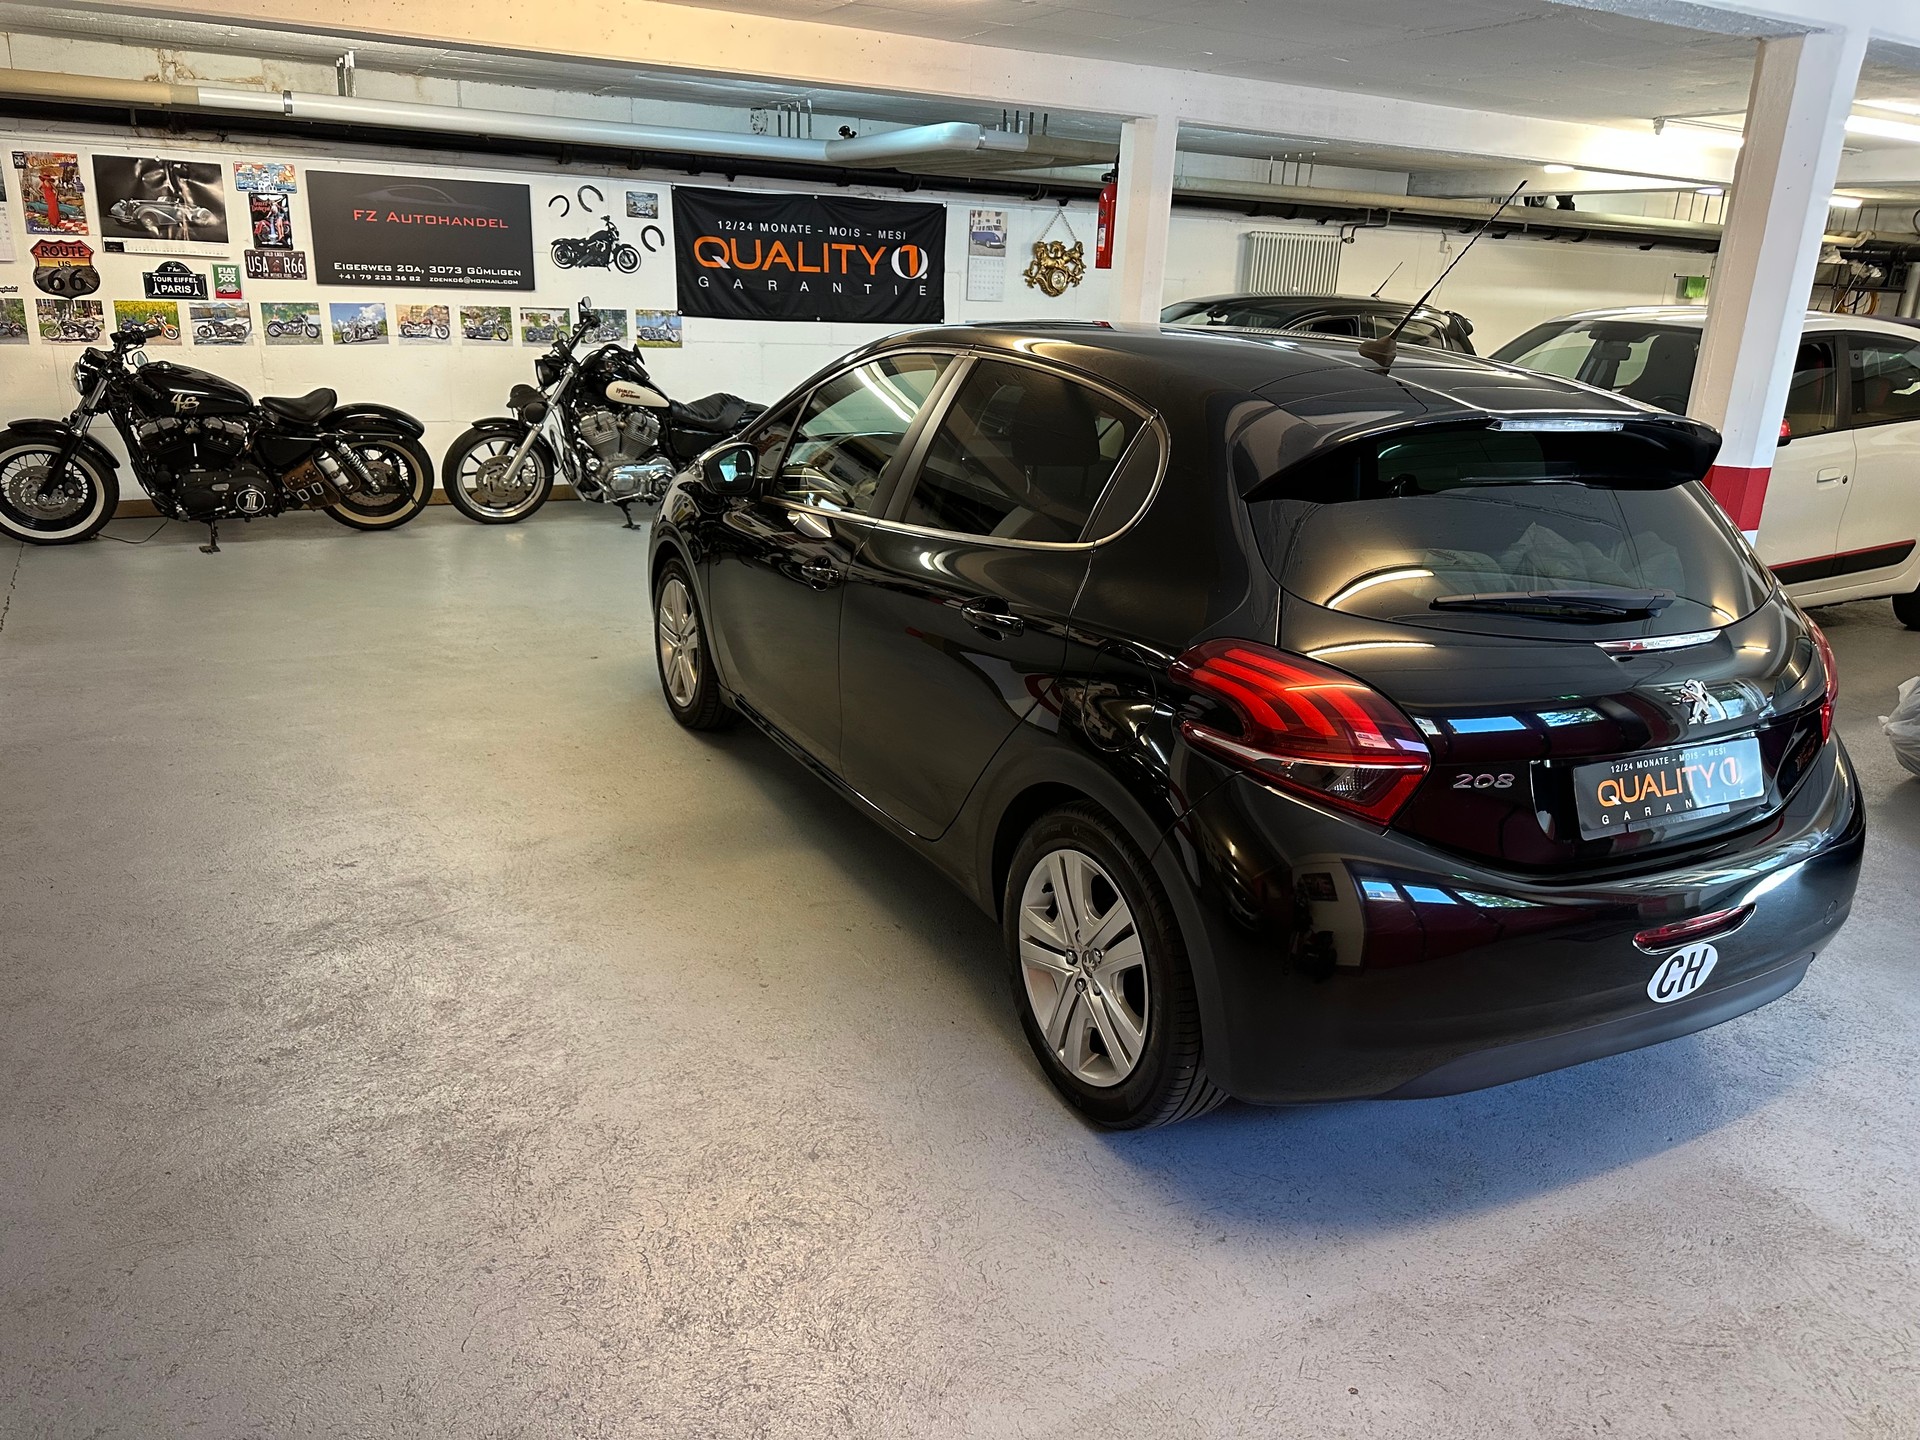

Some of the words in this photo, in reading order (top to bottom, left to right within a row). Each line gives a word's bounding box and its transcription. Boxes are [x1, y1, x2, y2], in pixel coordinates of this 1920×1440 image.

[353, 209, 378, 222] FZ
[717, 220, 753, 231] 12/24
[760, 223, 811, 234] MONATE
[829, 227, 860, 238] MOIS
[878, 230, 906, 240] MESI
[41, 245, 86, 257] ROUTE
[694, 235, 887, 276] QUALITY
[247, 256, 270, 273] USA
[283, 257, 305, 274] R66
[428, 265, 463, 275] 3073
[47, 268, 87, 291] 66
[161, 284, 192, 294] PARIS
[219, 275, 237, 283] 500
[697, 276, 927, 296] GARANTIE
[1610, 762, 1634, 774] 12/24
[1636, 756, 1669, 768] MONATE
[1679, 750, 1699, 762] MOIS
[1708, 747, 1726, 757] MESI
[1453, 773, 1515, 789] 208
[1597, 762, 1716, 808] QUALITY
[1601, 788, 1746, 826] GARANTIE
[1656, 947, 1709, 999] CH
